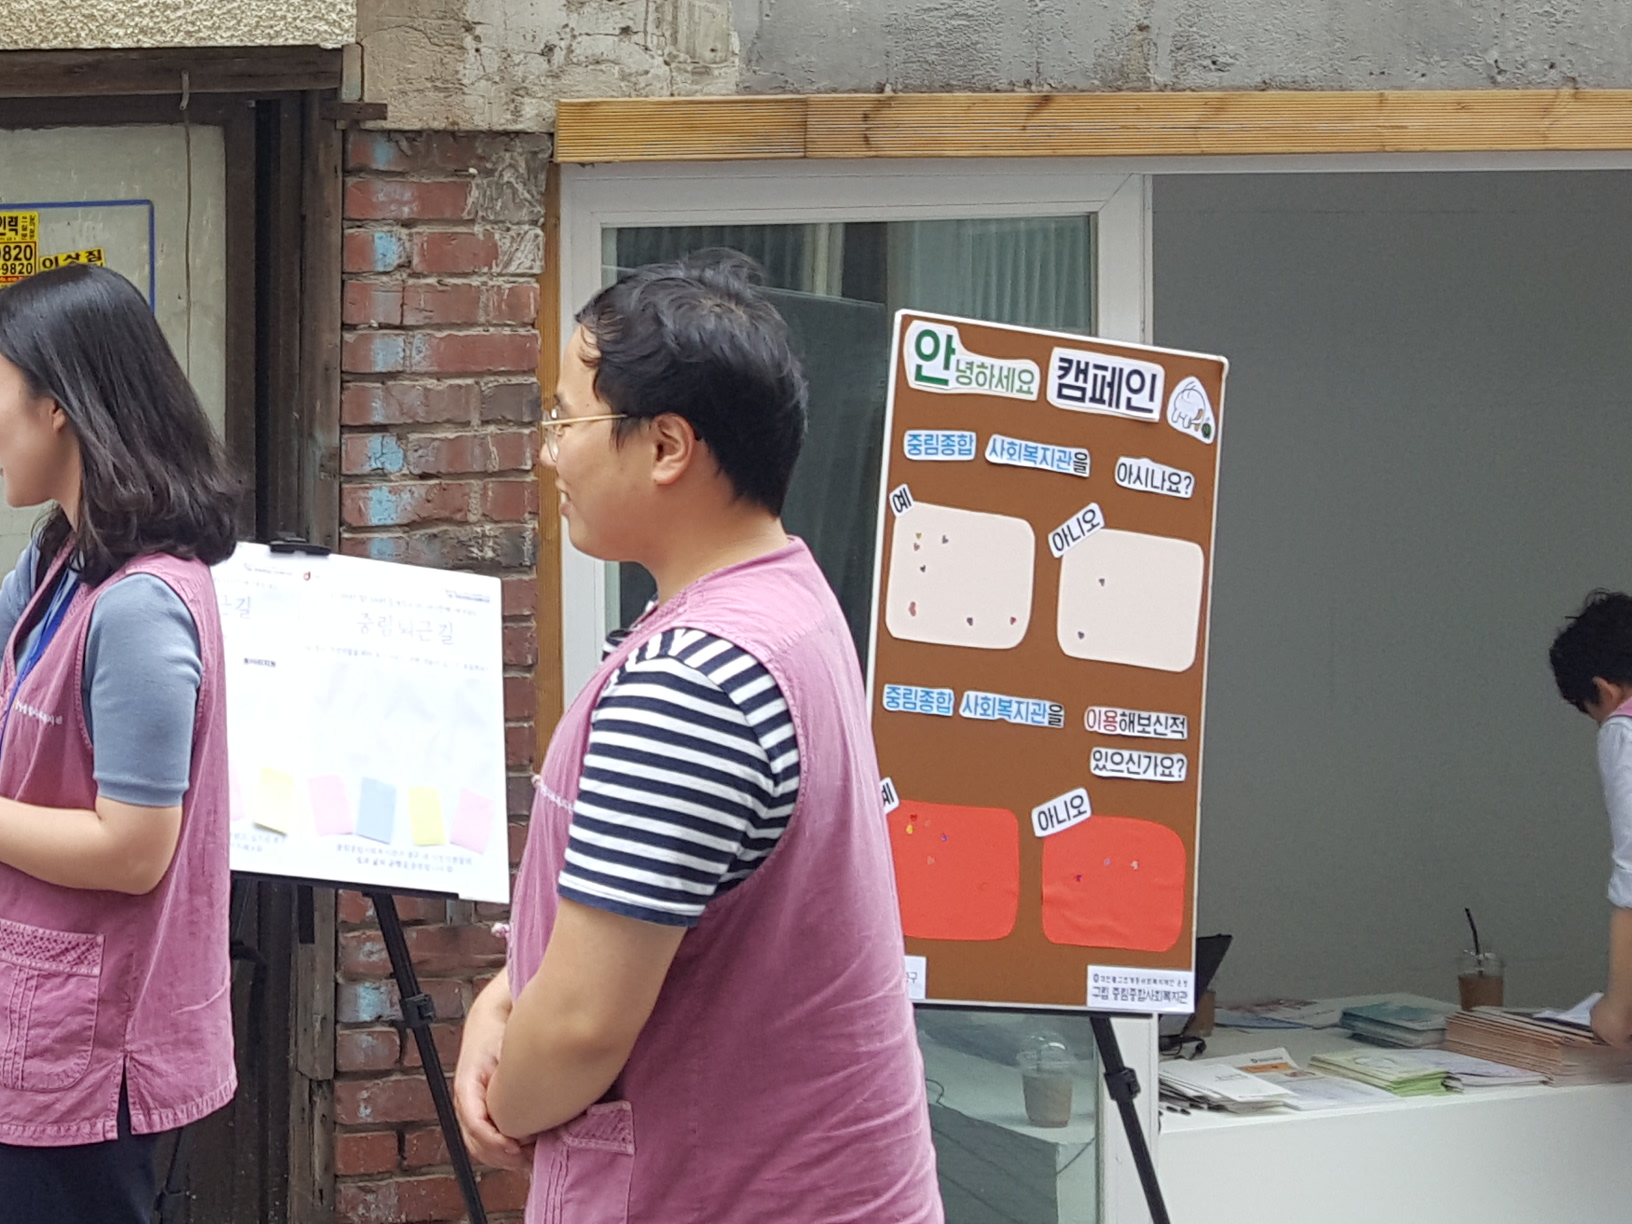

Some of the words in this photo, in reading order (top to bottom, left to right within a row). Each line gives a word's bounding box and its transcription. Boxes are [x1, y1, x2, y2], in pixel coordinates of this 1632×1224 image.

[914, 328, 1036, 396] 안녕하세요
[1056, 356, 1158, 414] 캠페인
[906, 432, 975, 457] 중림종합
[988, 441, 1089, 476] 사회복지관을
[1116, 461, 1193, 496] 아시나요?
[890, 488, 913, 514] 예
[1051, 507, 1101, 553] 아니오
[885, 686, 953, 714] 중림종합
[961, 694, 1064, 728] 사회복지관을
[1085, 708, 1186, 738] 이용해보신적
[1092, 748, 1186, 779] 있으신가요?
[1036, 793, 1088, 831] 아니오
